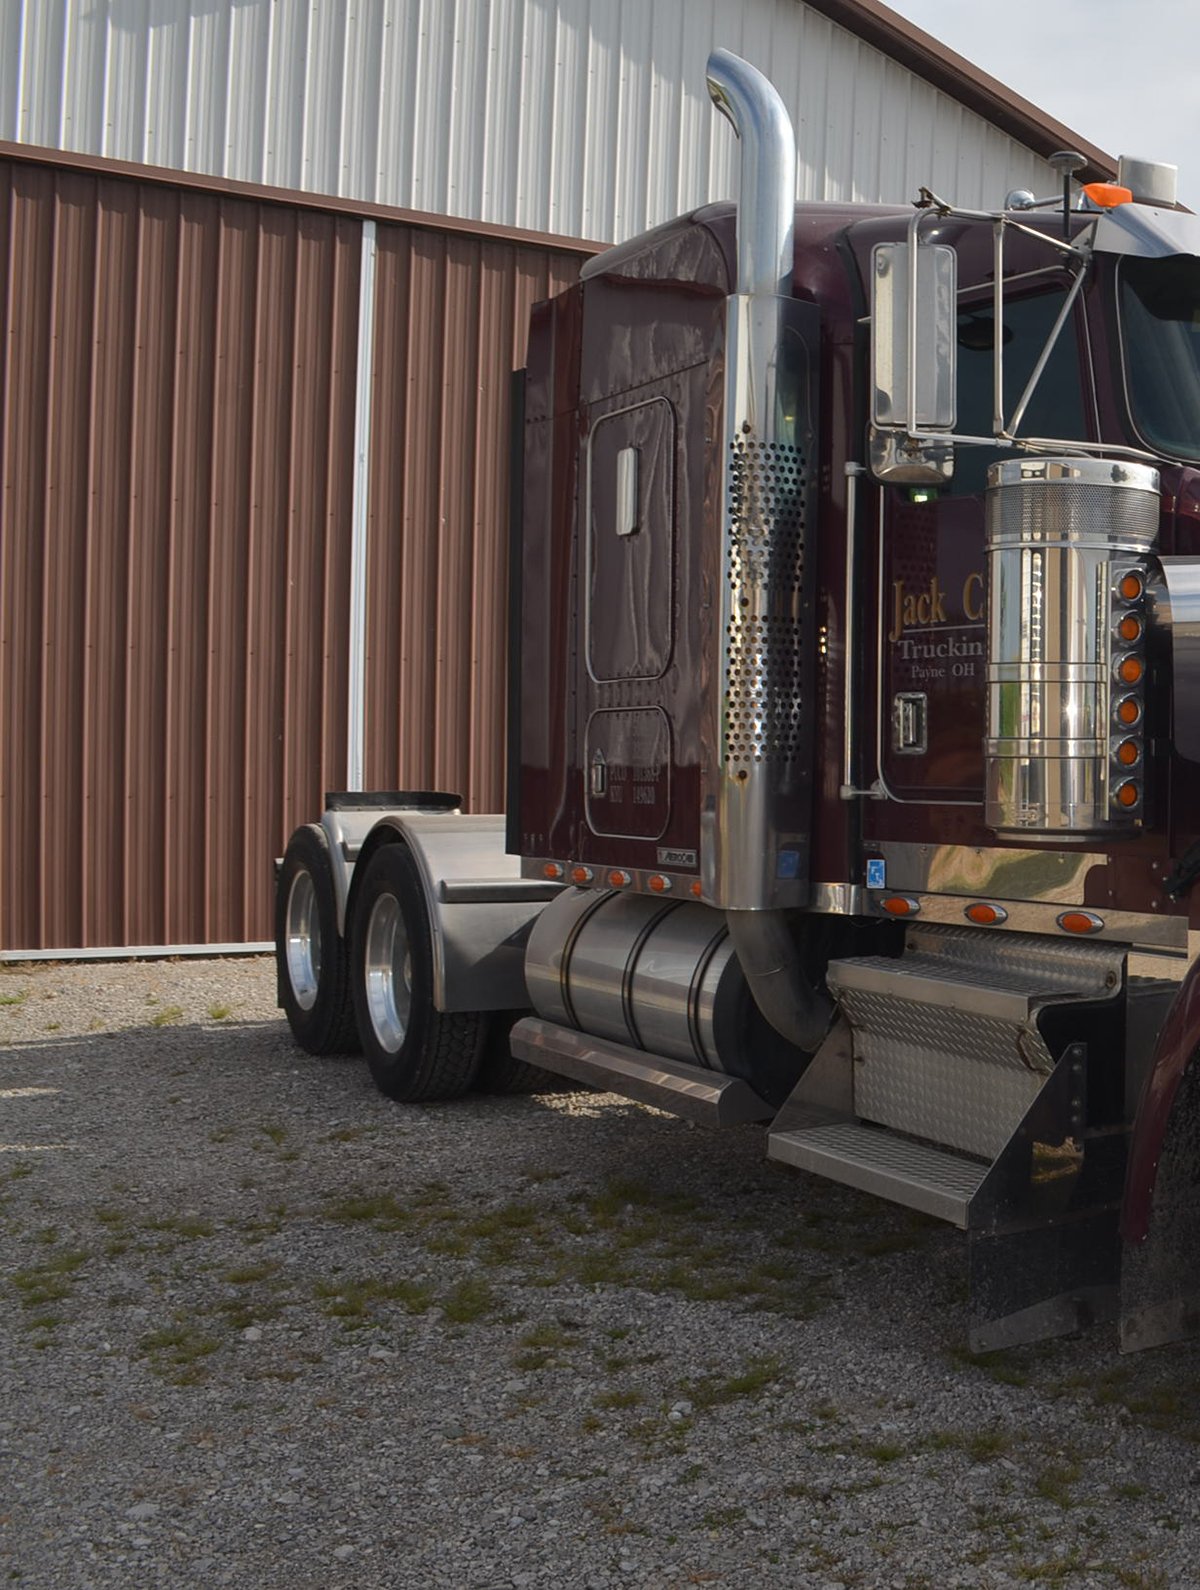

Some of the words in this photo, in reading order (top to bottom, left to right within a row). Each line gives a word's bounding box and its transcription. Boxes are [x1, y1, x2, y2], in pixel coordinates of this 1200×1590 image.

[889, 577, 947, 642] Jack
[897, 636, 984, 660] Truckin
[911, 664, 945, 681] Payne
[952, 662, 975, 676] OH
